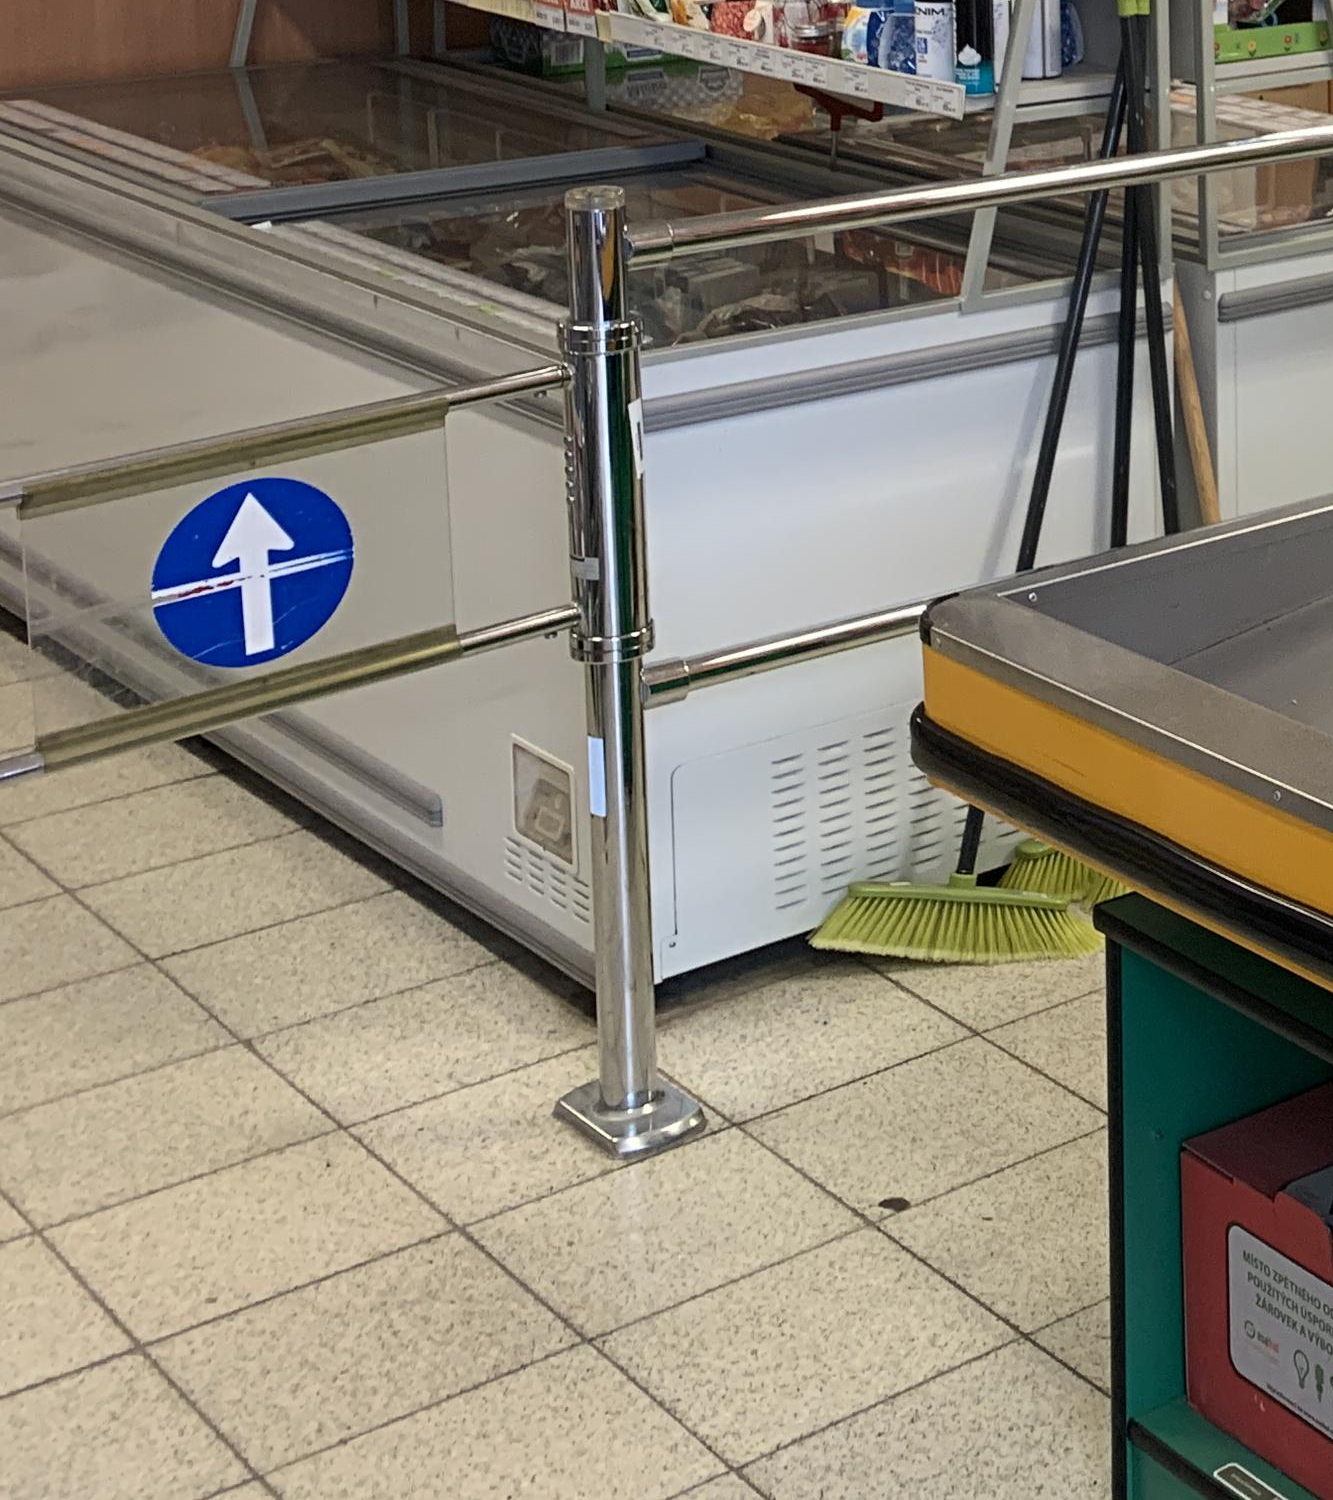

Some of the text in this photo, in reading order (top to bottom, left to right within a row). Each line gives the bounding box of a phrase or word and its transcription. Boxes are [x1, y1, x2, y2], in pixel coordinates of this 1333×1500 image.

[1242, 1249, 1272, 1279] MÍSTO
[1272, 1264, 1322, 1311] ZPĚTNÉHO
[1247, 1271, 1299, 1314] POUŽITÝCH
[1255, 1291, 1299, 1337] ŽÁROVEK
